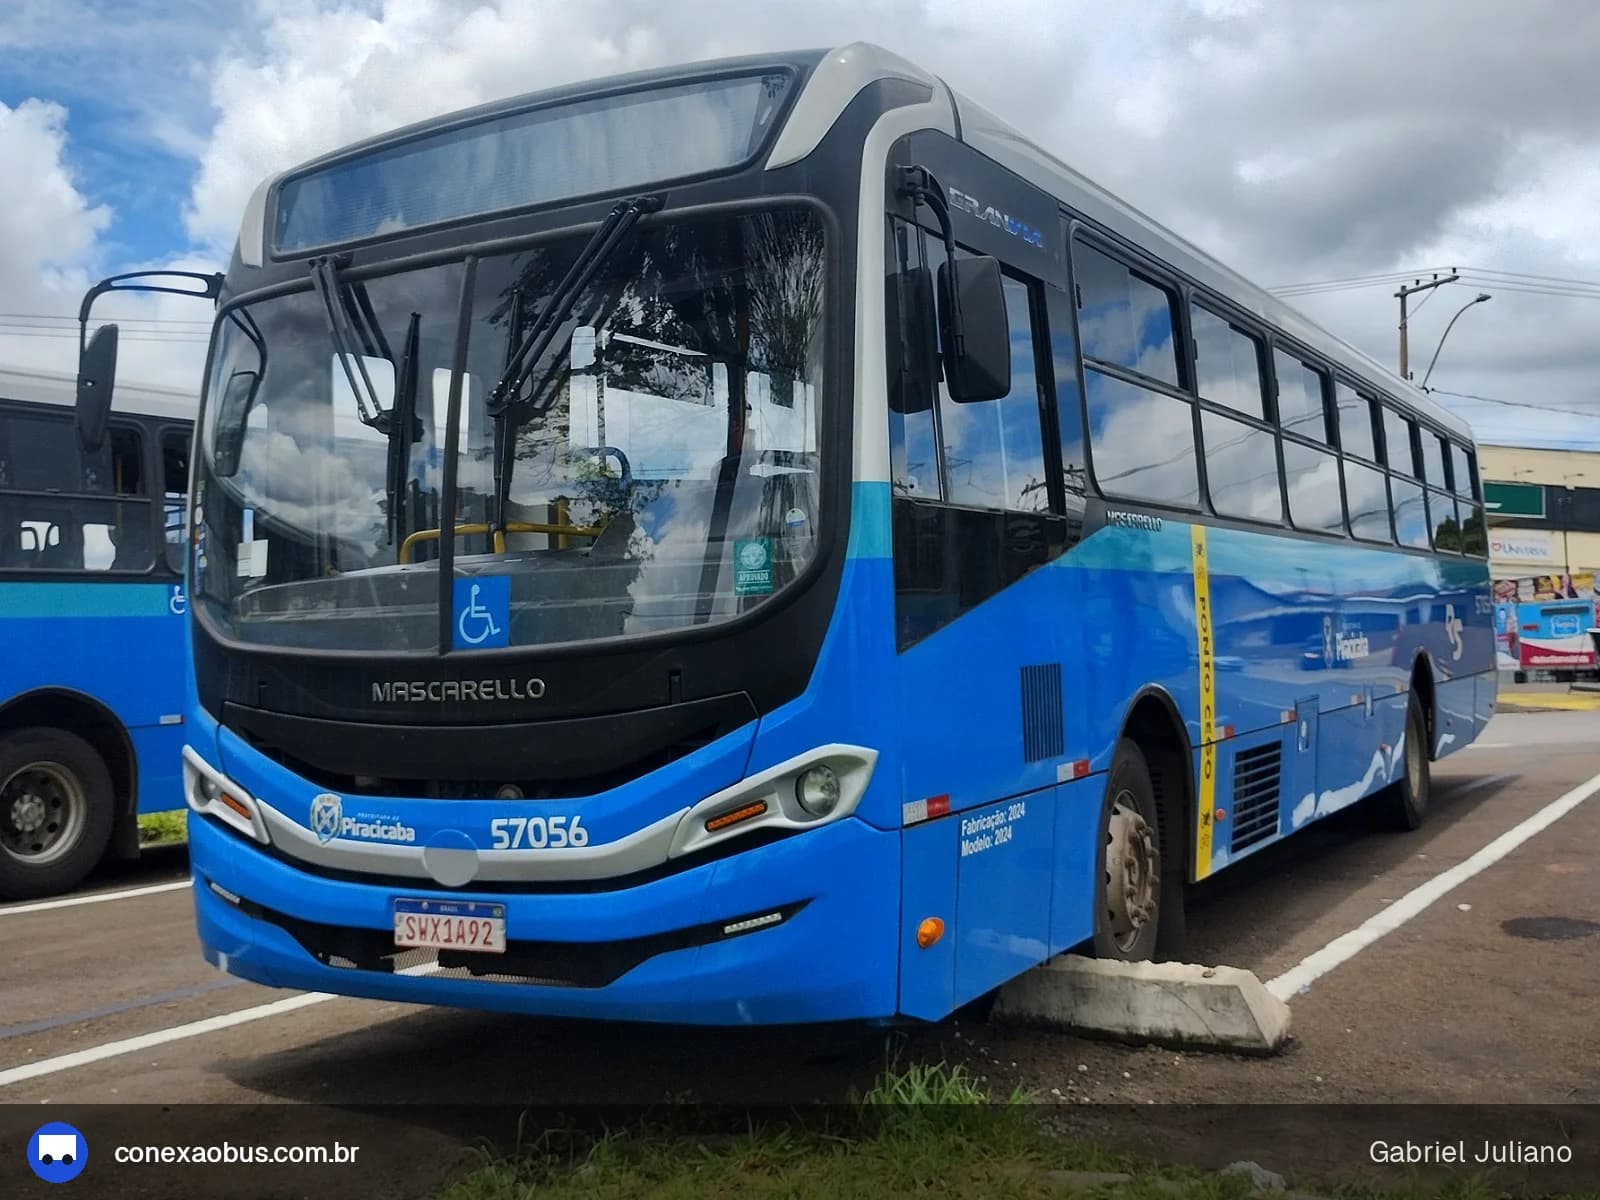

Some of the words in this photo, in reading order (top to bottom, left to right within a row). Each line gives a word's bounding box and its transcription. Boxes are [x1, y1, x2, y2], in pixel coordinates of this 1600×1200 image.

[1199, 597, 1211, 693] PONTO
[371, 678, 546, 702] MASCARELLO
[341, 816, 416, 842] Piracicaba
[491, 815, 589, 849] 57056
[961, 809, 1006, 836] Fabricação:
[1008, 801, 1025, 821] 2024
[961, 834, 993, 856] Modelo:
[994, 825, 1012, 845] 2024
[405, 916, 493, 946] SWX1A92
